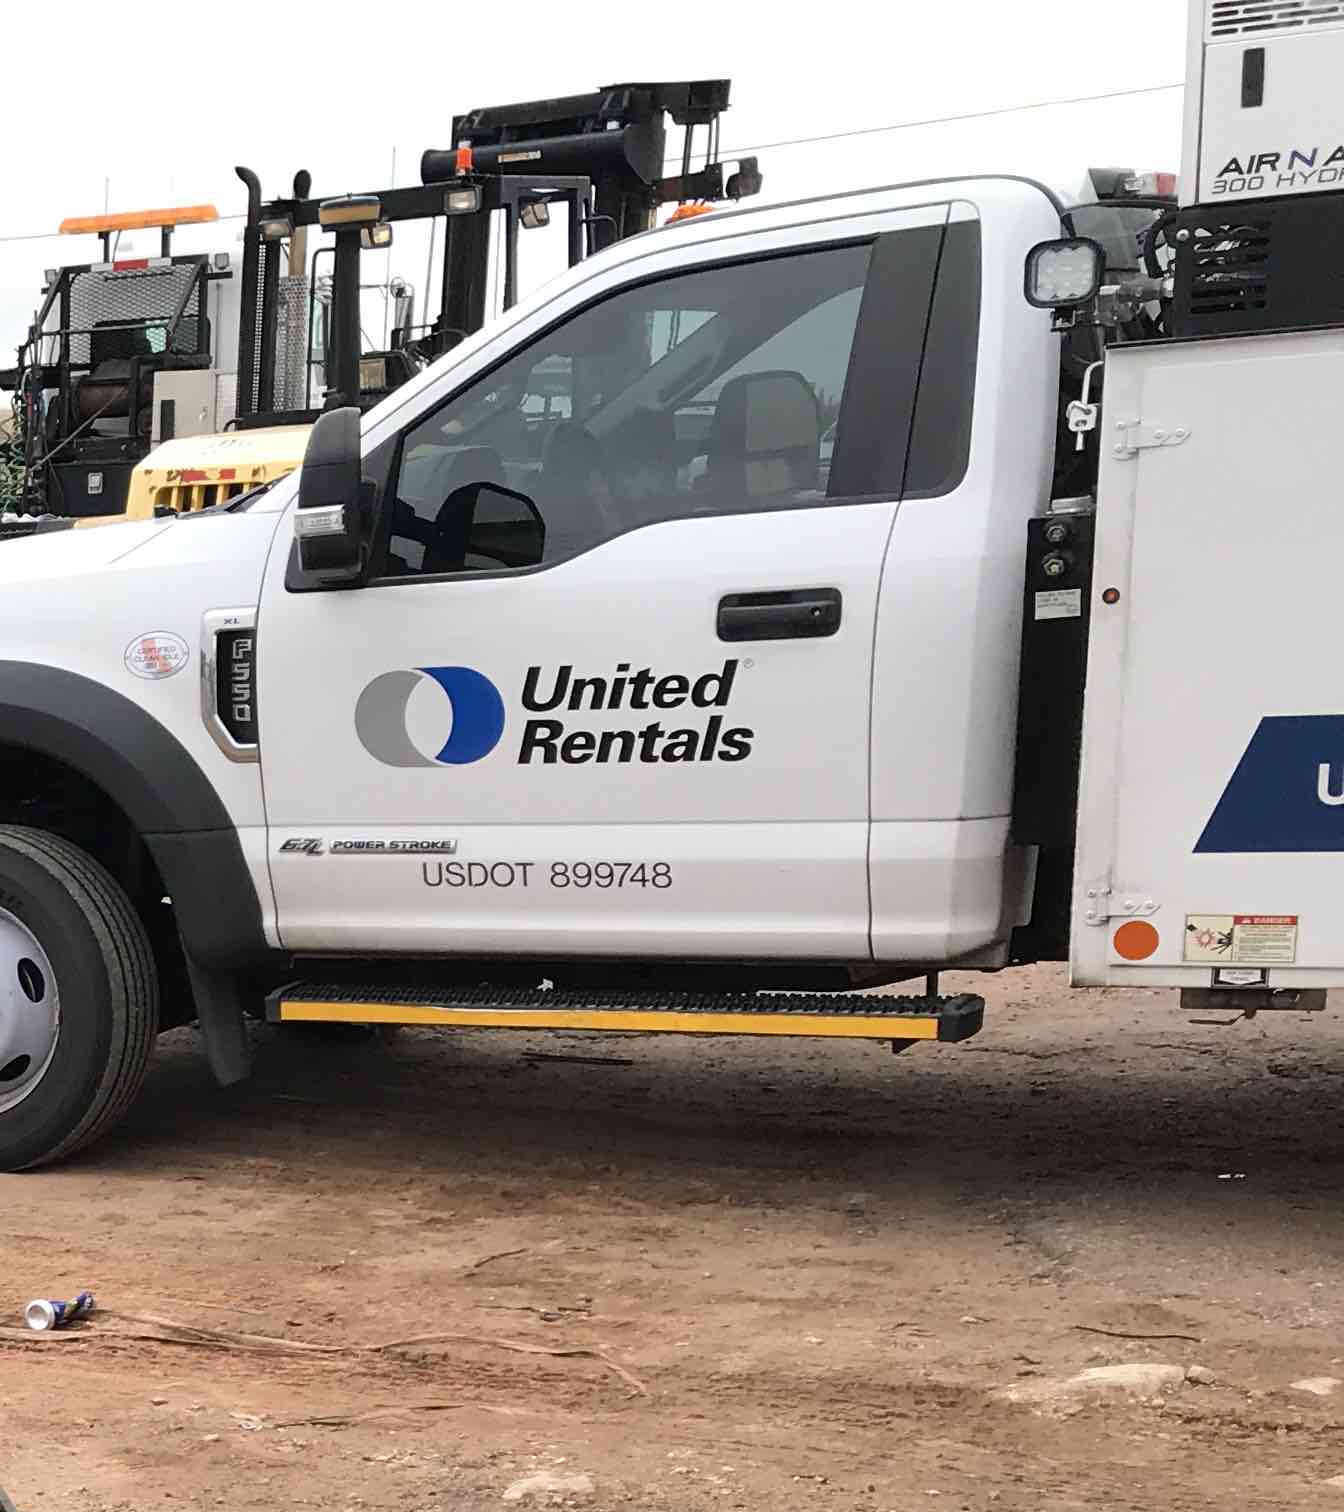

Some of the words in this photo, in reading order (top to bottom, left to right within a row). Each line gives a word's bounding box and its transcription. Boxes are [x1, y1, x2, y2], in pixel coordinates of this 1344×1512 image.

[1216, 152, 1280, 178] AIR
[1212, 176, 1264, 194] 300
[232, 638, 252, 722] F550
[518, 658, 739, 712] United
[517, 716, 755, 766] Rentals
[333, 840, 385, 850] POWER
[389, 839, 452, 850] STROKE
[421, 862, 535, 888] USDOT
[549, 862, 674, 889] 899748
